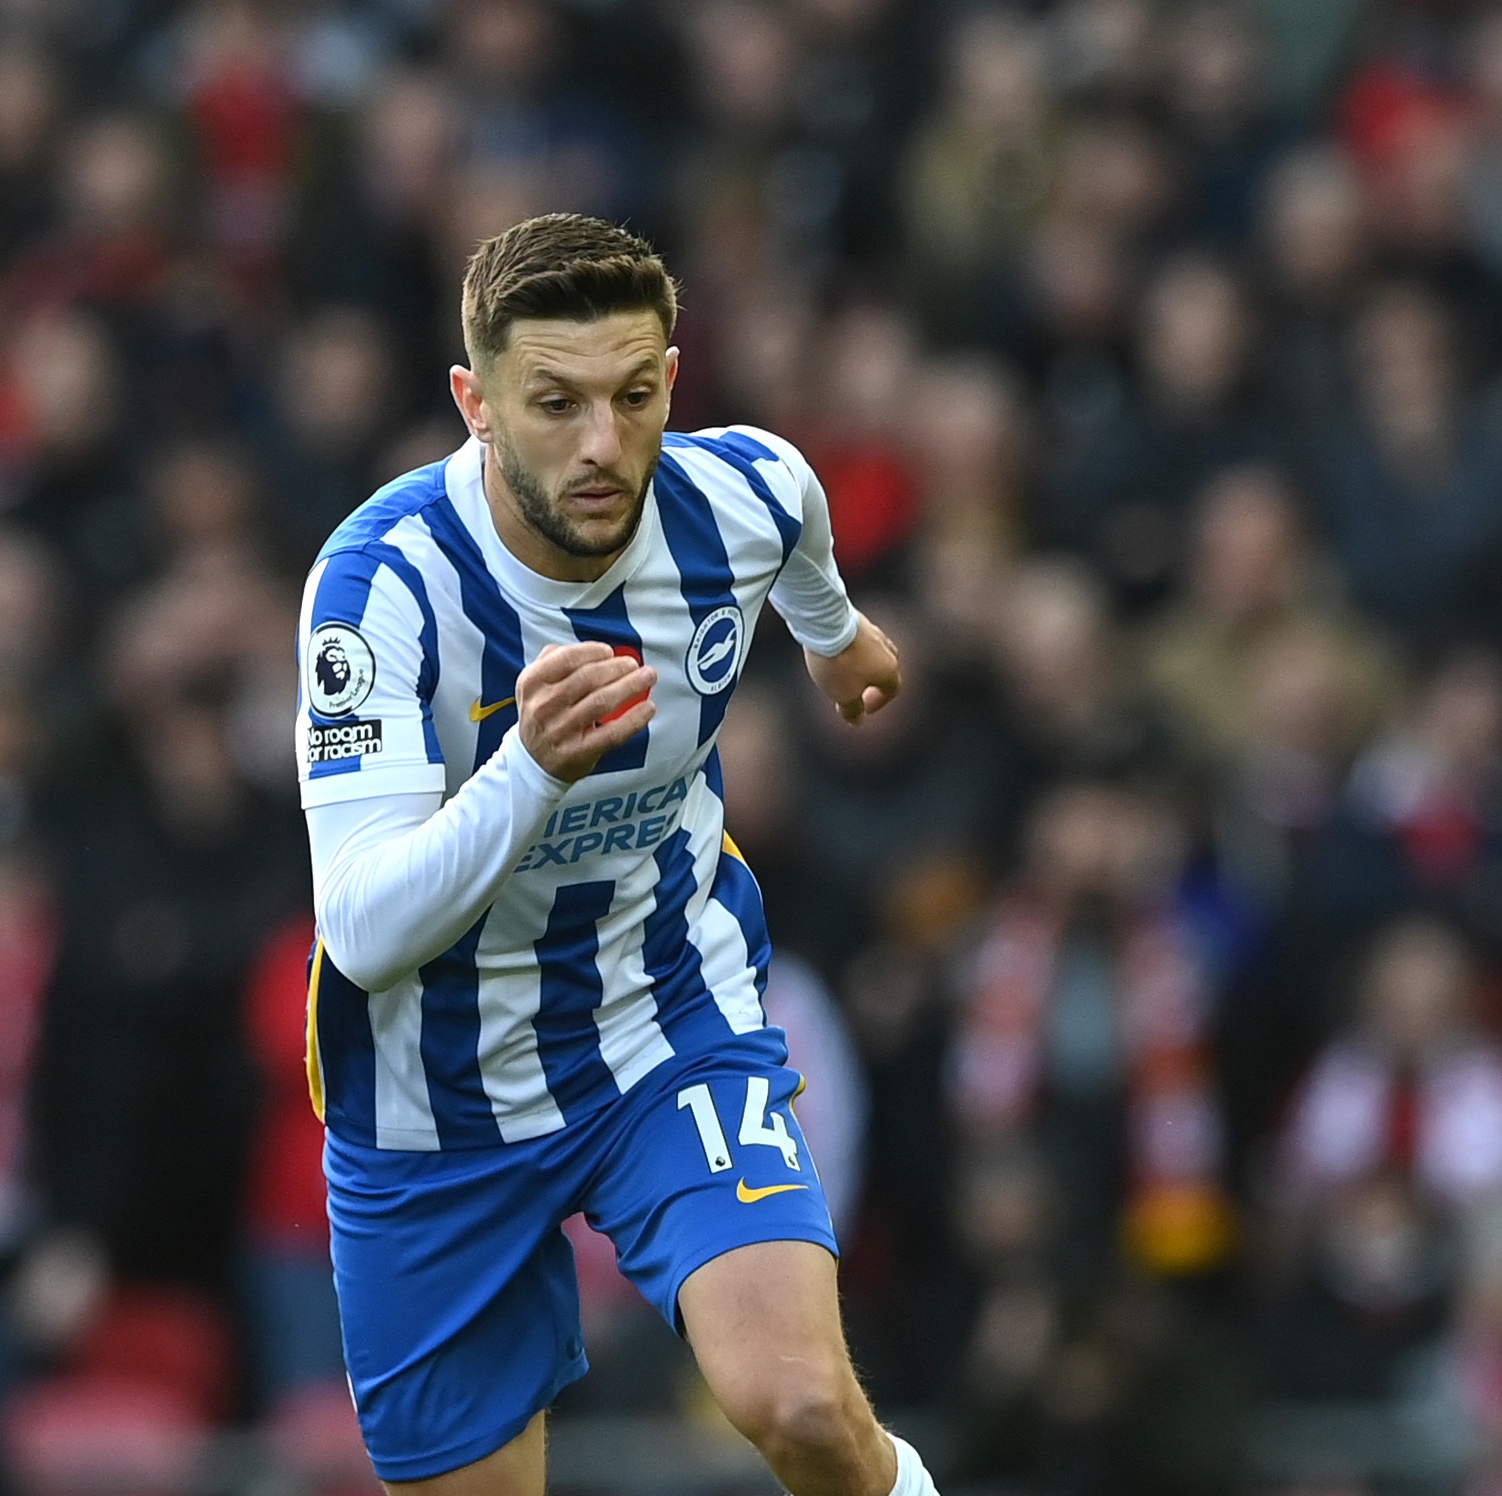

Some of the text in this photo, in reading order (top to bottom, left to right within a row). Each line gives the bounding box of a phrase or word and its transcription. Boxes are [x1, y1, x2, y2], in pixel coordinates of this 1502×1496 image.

[307, 738, 382, 763] or racism
[324, 724, 373, 744] room
[543, 776, 688, 838] ERICA
[513, 809, 678, 873] XPRE
[677, 1076, 801, 1174] 14
